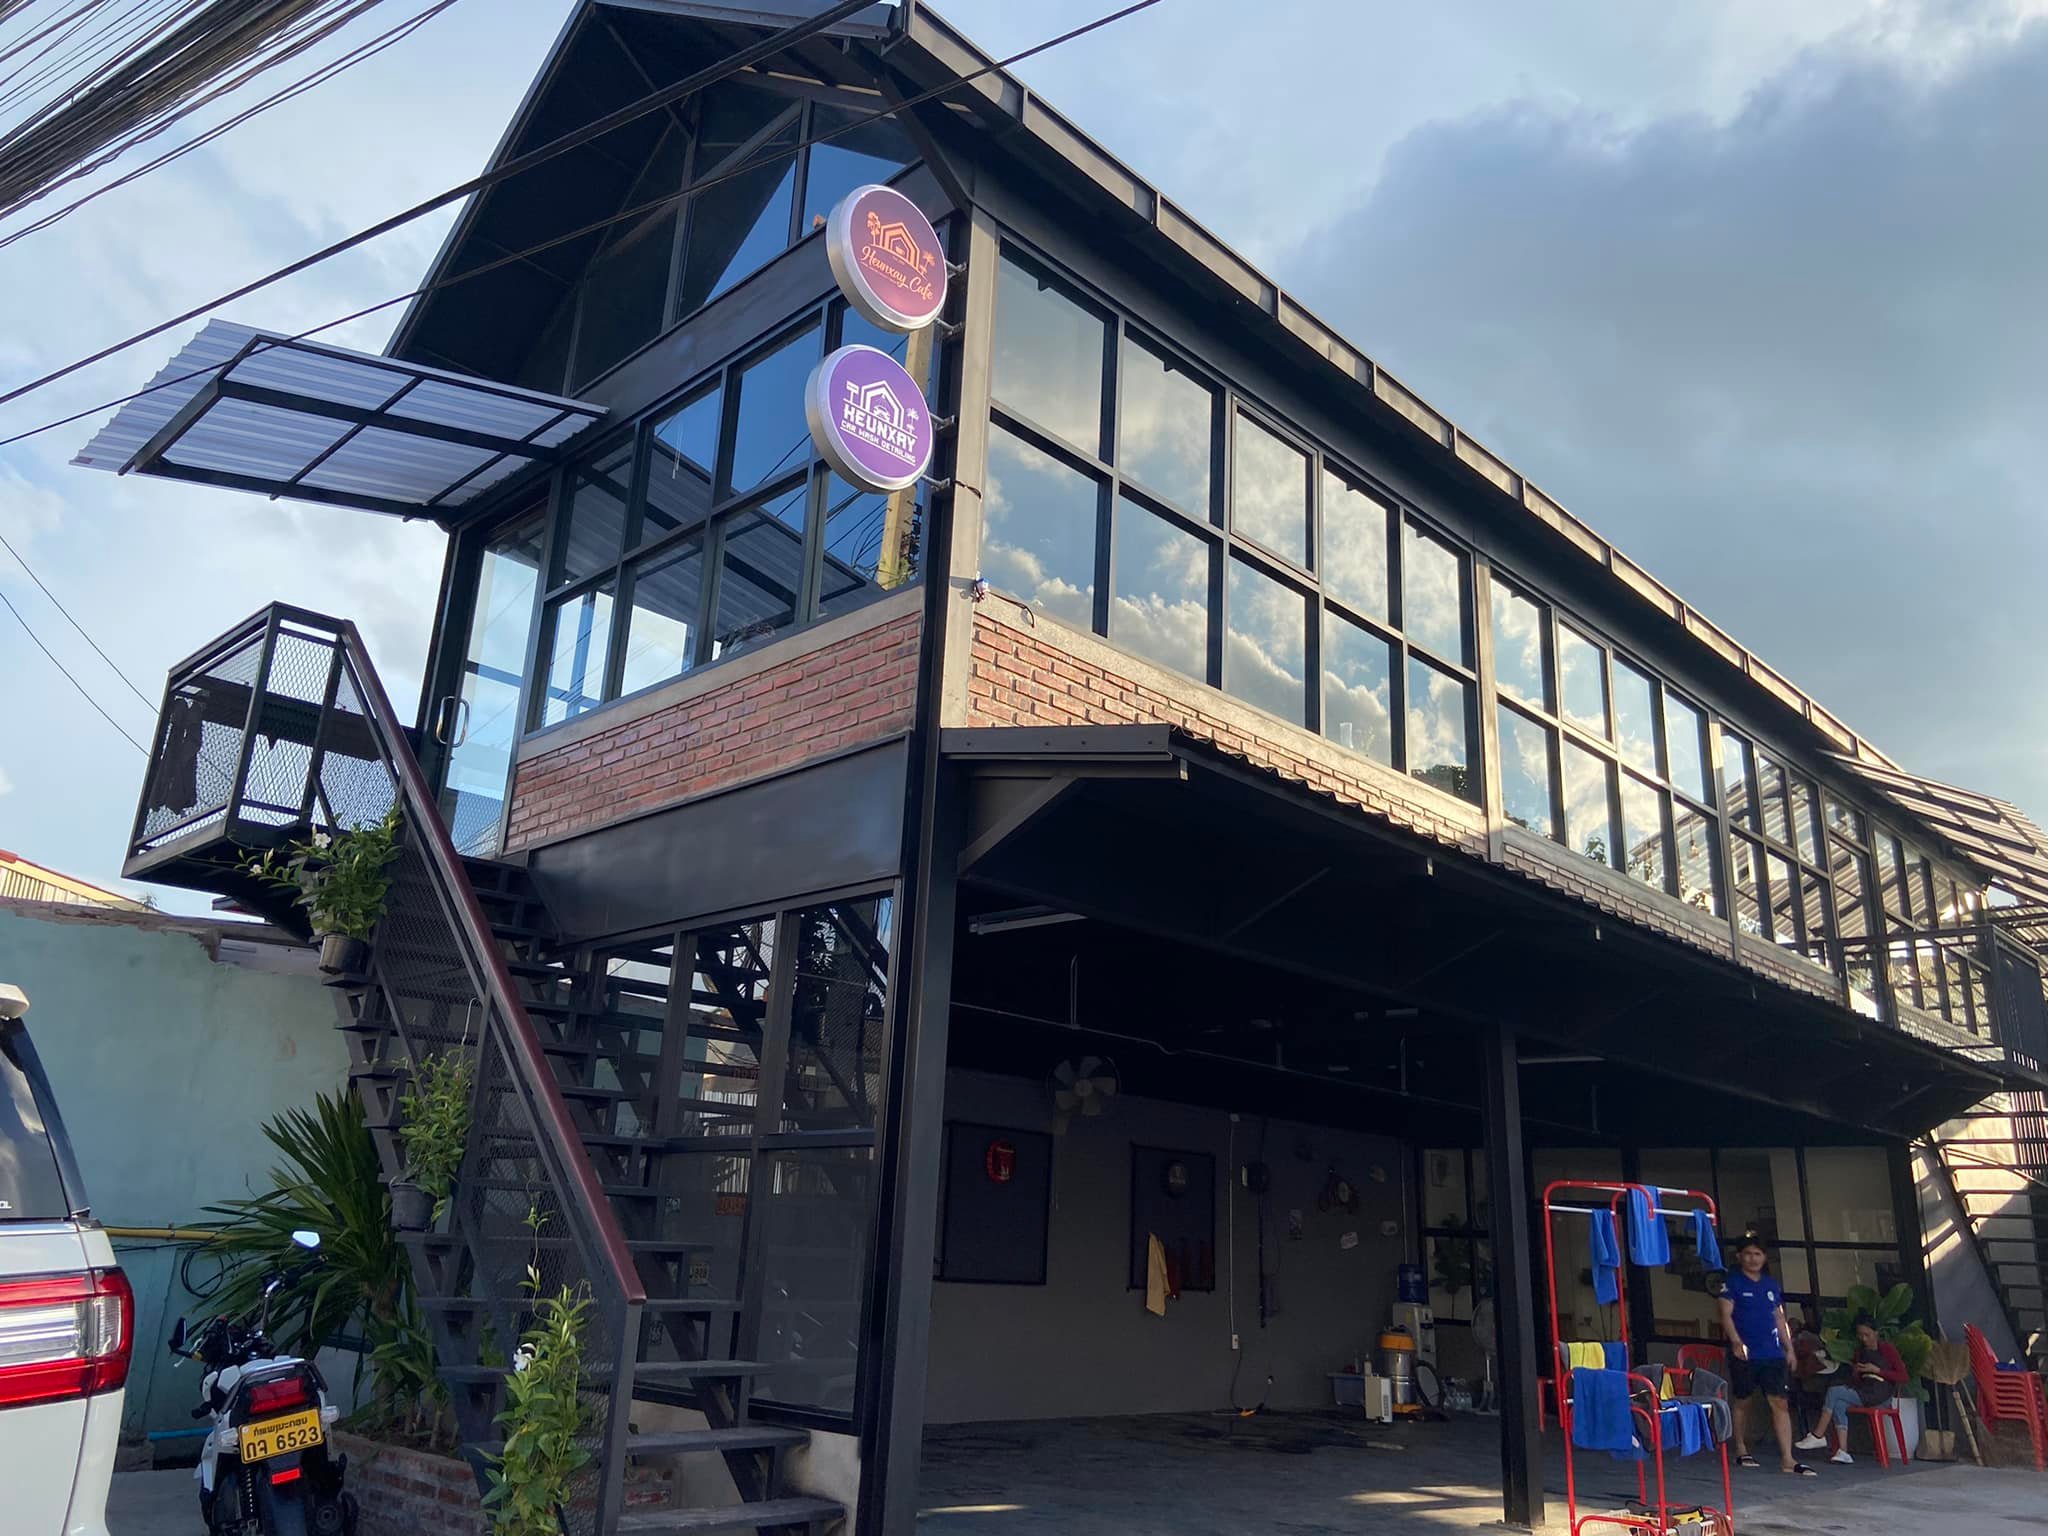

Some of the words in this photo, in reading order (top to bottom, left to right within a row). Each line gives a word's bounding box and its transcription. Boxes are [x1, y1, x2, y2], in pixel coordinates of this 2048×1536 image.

[841, 420, 856, 432] CAR
[858, 428, 880, 444] WASH
[881, 439, 916, 463] DETAILING
[843, 403, 916, 453] HEUNXAY
[276, 1426, 319, 1450] 6523
